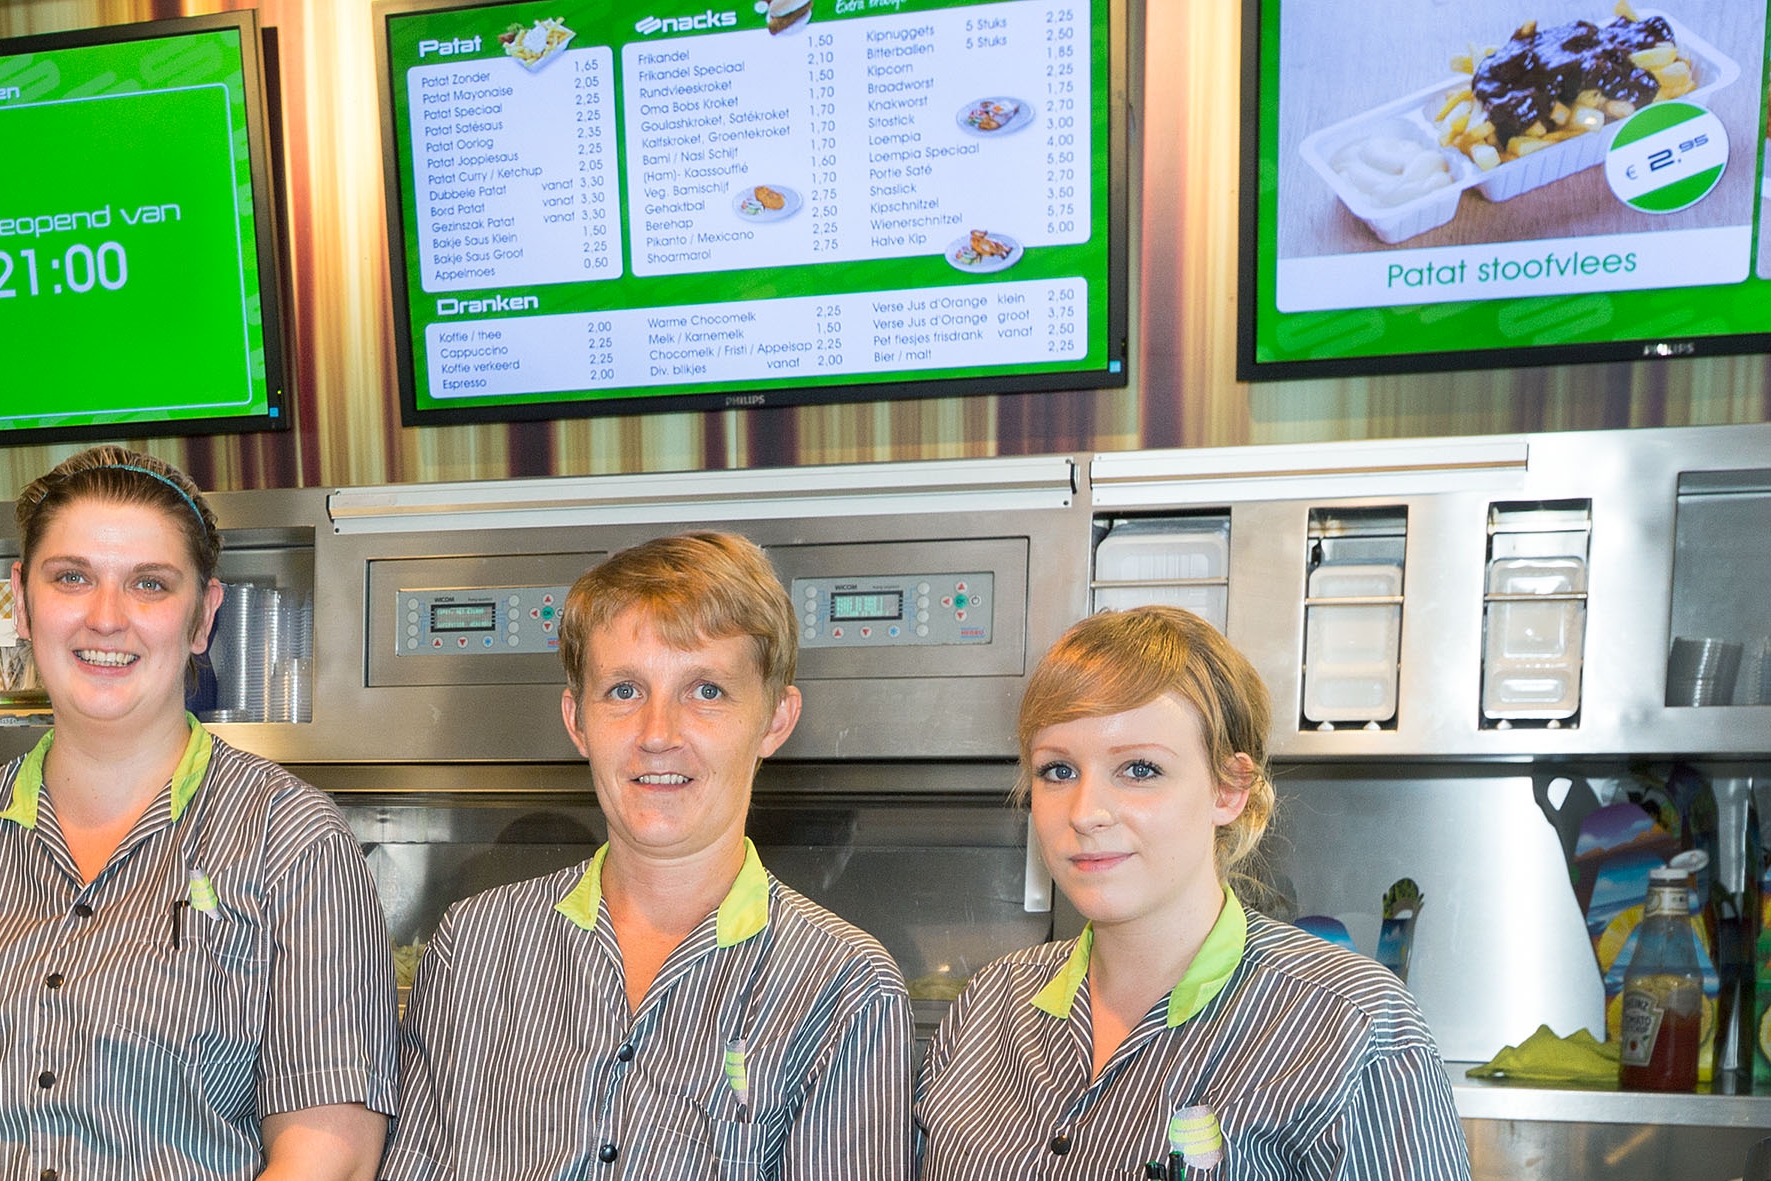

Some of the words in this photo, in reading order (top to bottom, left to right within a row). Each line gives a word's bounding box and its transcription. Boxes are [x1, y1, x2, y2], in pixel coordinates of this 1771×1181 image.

[419, 35, 482, 57] Patat
[639, 51, 689, 65] Frikandel
[808, 34, 833, 47] 1,50
[422, 77, 449, 88] Patat
[452, 72, 490, 83] Zonder
[575, 60, 598, 72] 1,65
[639, 68, 690, 81] Frikandel
[693, 62, 745, 77] Speciaal
[807, 52, 834, 65] 2,10
[867, 63, 913, 77] Kipcorn
[868, 78, 934, 94] Braadworst
[1046, 64, 1073, 77] 2,25
[423, 92, 451, 104] Patat
[453, 86, 513, 101] Mayonaise
[574, 76, 599, 89] 2,05
[640, 81, 732, 98] Rundvleeskroket
[808, 69, 834, 82] 1,50
[868, 96, 928, 111] Knakworst
[1047, 82, 1074, 94] 1,75
[424, 109, 451, 120] Patat
[454, 103, 502, 119] Speciaal
[575, 93, 600, 106] 2,25
[640, 104, 669, 115] Oma
[673, 100, 700, 113] Bobs
[703, 97, 738, 110] Kroket
[809, 86, 835, 99] 1,70
[425, 125, 452, 137] Patat
[576, 110, 601, 122] 2,25
[869, 131, 921, 146] Loempia
[1047, 117, 1074, 129] 3,00
[426, 141, 453, 153] Patat
[456, 138, 494, 150] Oorlog
[577, 127, 602, 139] 2,35
[427, 157, 454, 169] Patat
[458, 152, 519, 167] Joppiesaus
[578, 143, 602, 155] 2,25
[870, 168, 902, 181] Portie
[1047, 152, 1074, 164] 5,50
[429, 188, 476, 200] Dubbele
[479, 185, 506, 196] Patat
[541, 180, 573, 191] vanaf
[579, 176, 604, 188] 3,30
[121, 202, 180, 226] van
[645, 200, 705, 215] Gehaktbal
[812, 189, 837, 201] 2,75
[432, 220, 484, 233] Gezinszak
[487, 217, 515, 228] Patat
[543, 212, 575, 223] vanaf
[582, 209, 606, 221] 3,30
[646, 219, 693, 231] Berehap
[812, 206, 837, 218] 2,50
[871, 214, 963, 231] Wienerschnitzel
[1047, 204, 1074, 217] 5,75
[433, 237, 462, 250] Bakje
[465, 235, 489, 245] Saus
[492, 233, 518, 244] Klein
[583, 225, 607, 237] 1,50
[871, 234, 904, 247] Halve
[908, 233, 927, 246] Kip
[1047, 221, 1074, 234] 5,00
[647, 250, 711, 264] Shoarmarol
[813, 240, 838, 251] 2,75
[435, 268, 495, 280] Appelmoes
[584, 258, 608, 269] 0,50
[1388, 261, 1468, 289] Patat
[1477, 250, 1638, 283] stoofvlees
[437, 295, 539, 316] Dranken
[872, 302, 904, 313] Verse
[907, 300, 926, 312] Jus
[997, 294, 1025, 305] klein
[1047, 289, 1074, 302] 2,50
[648, 315, 687, 329] Warme
[690, 311, 756, 326] Chocomelk
[816, 306, 841, 318] 2,25
[440, 346, 508, 360] Cappuccino
[589, 338, 612, 350] 2,25
[651, 366, 670, 377] Div.
[673, 363, 707, 376] blikjes
[767, 358, 800, 369] vanaf
[817, 355, 843, 367] 2,00
[443, 378, 487, 390] Espresso
[590, 369, 614, 381] 2,00
